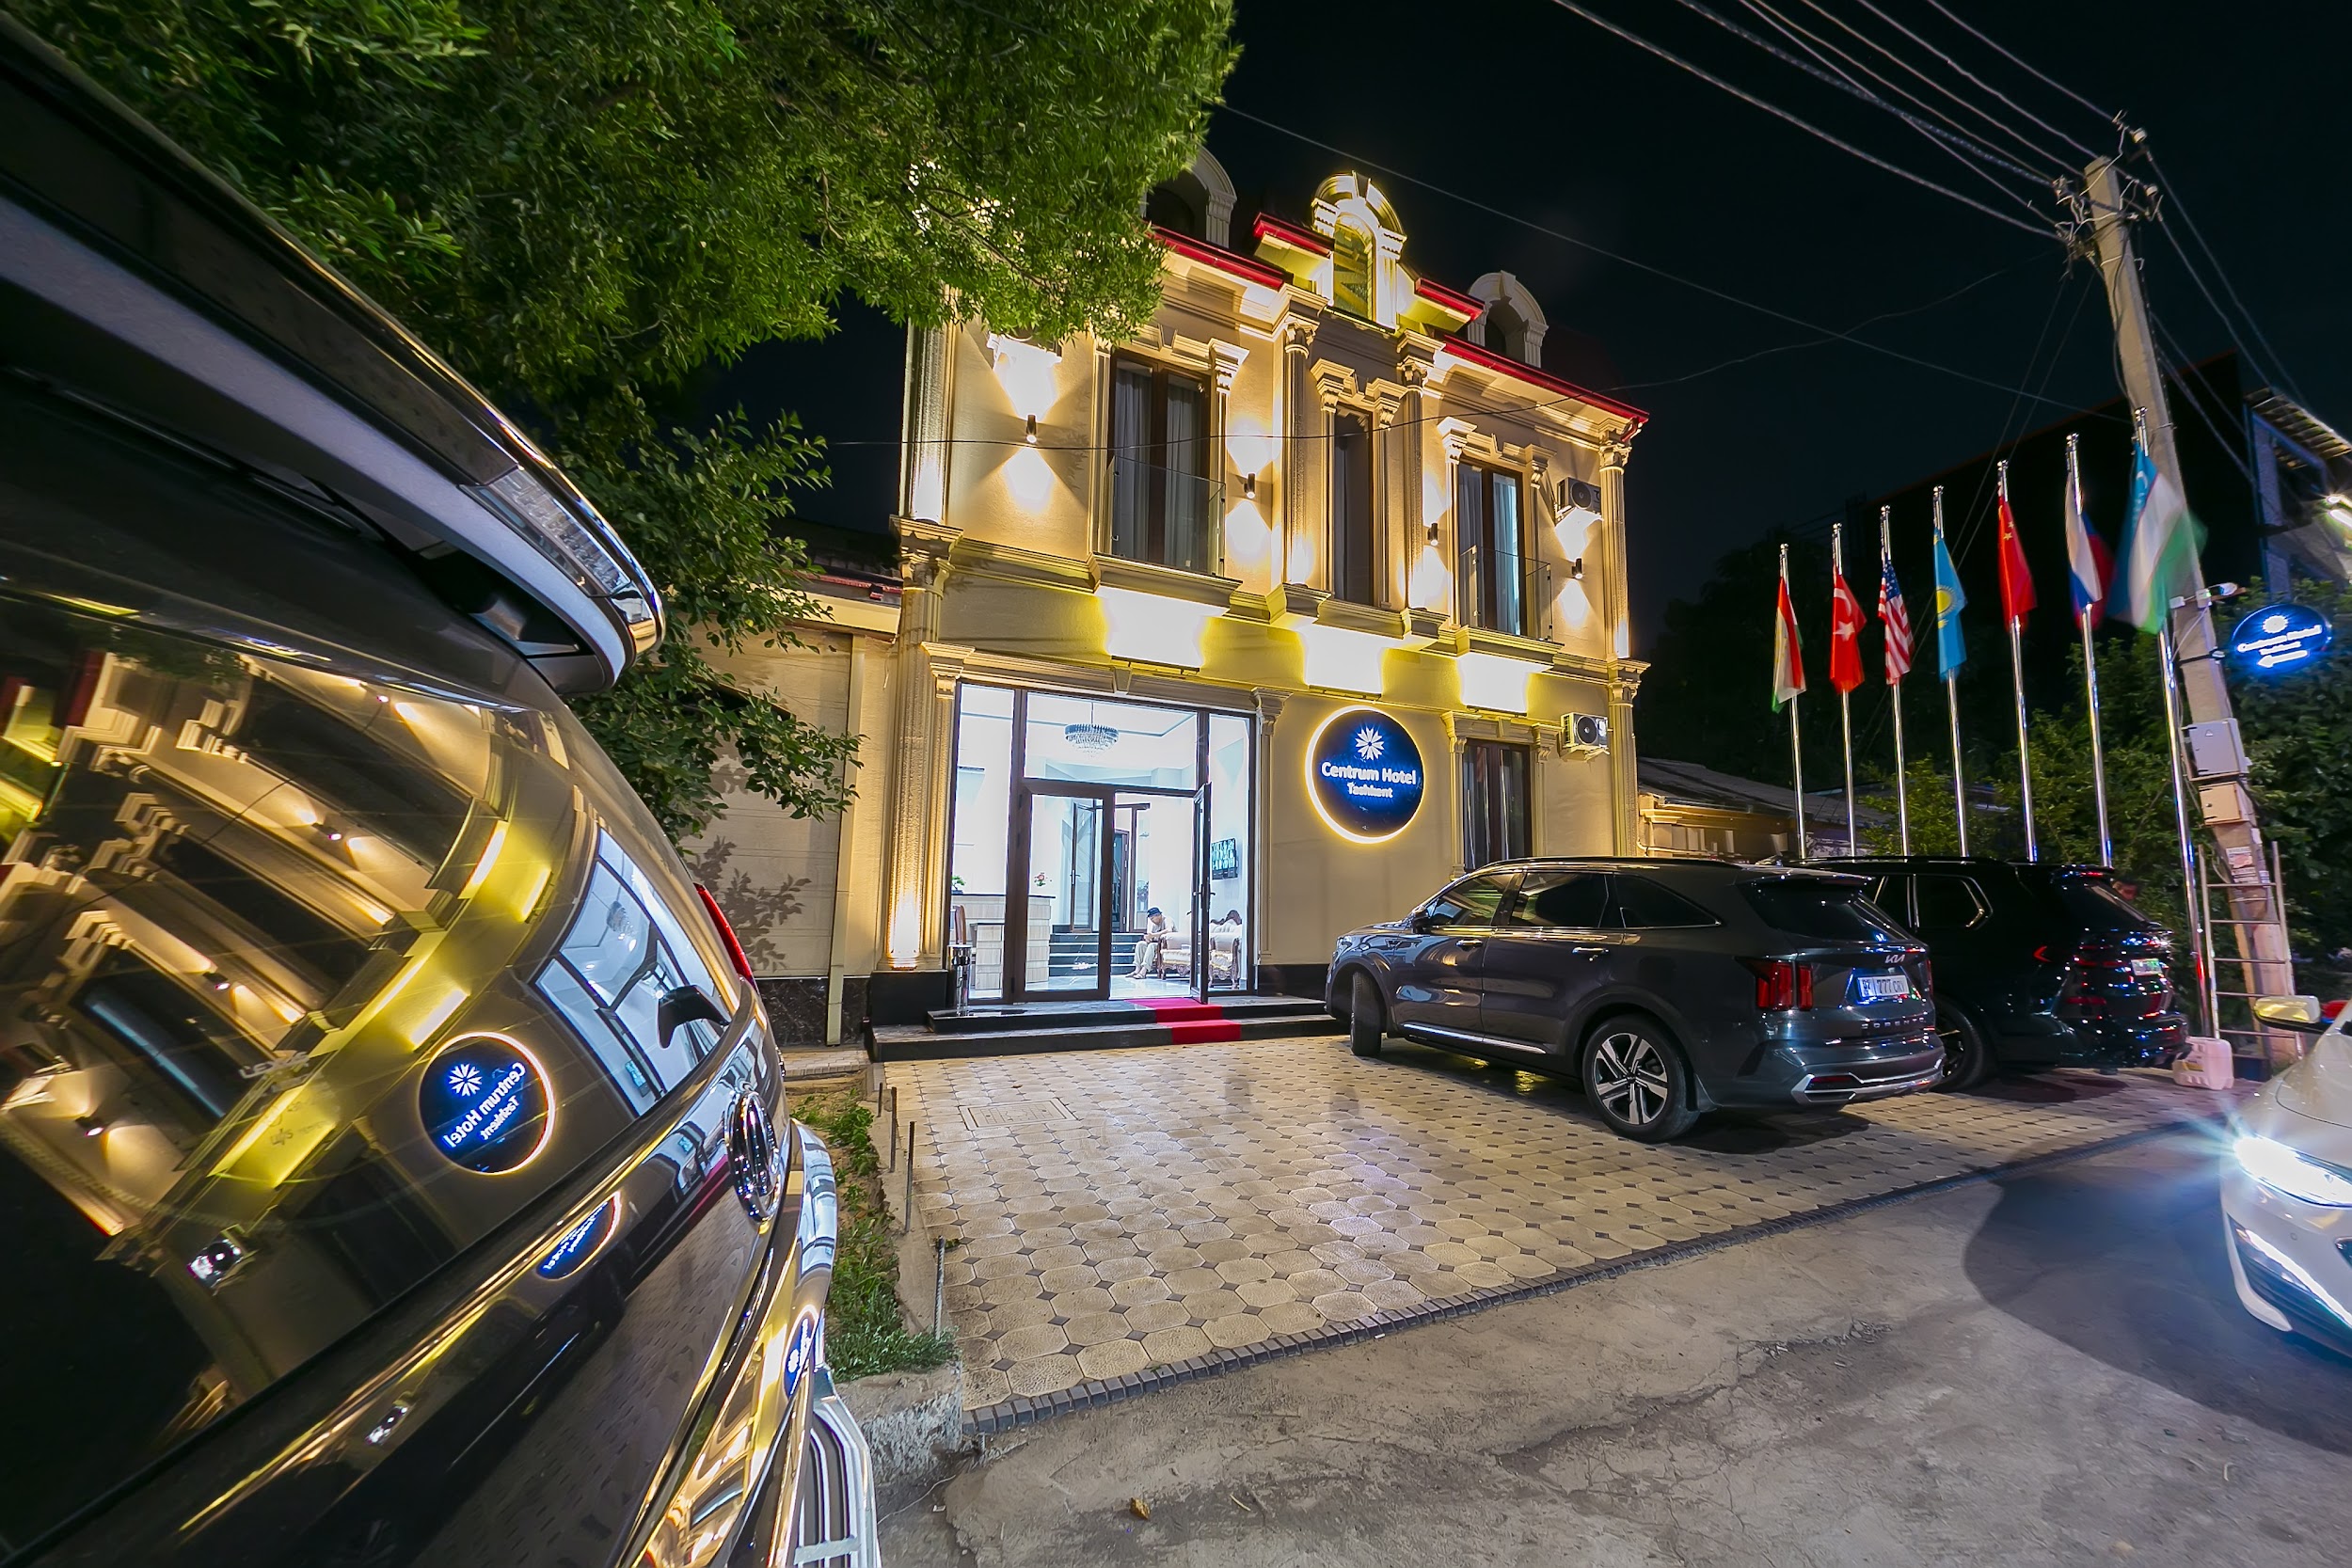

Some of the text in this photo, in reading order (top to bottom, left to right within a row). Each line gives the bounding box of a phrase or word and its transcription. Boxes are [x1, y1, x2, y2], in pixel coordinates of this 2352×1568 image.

[1321, 761, 1417, 785] Centrum Hotel
[1346, 782, 1394, 799] Tashkent
